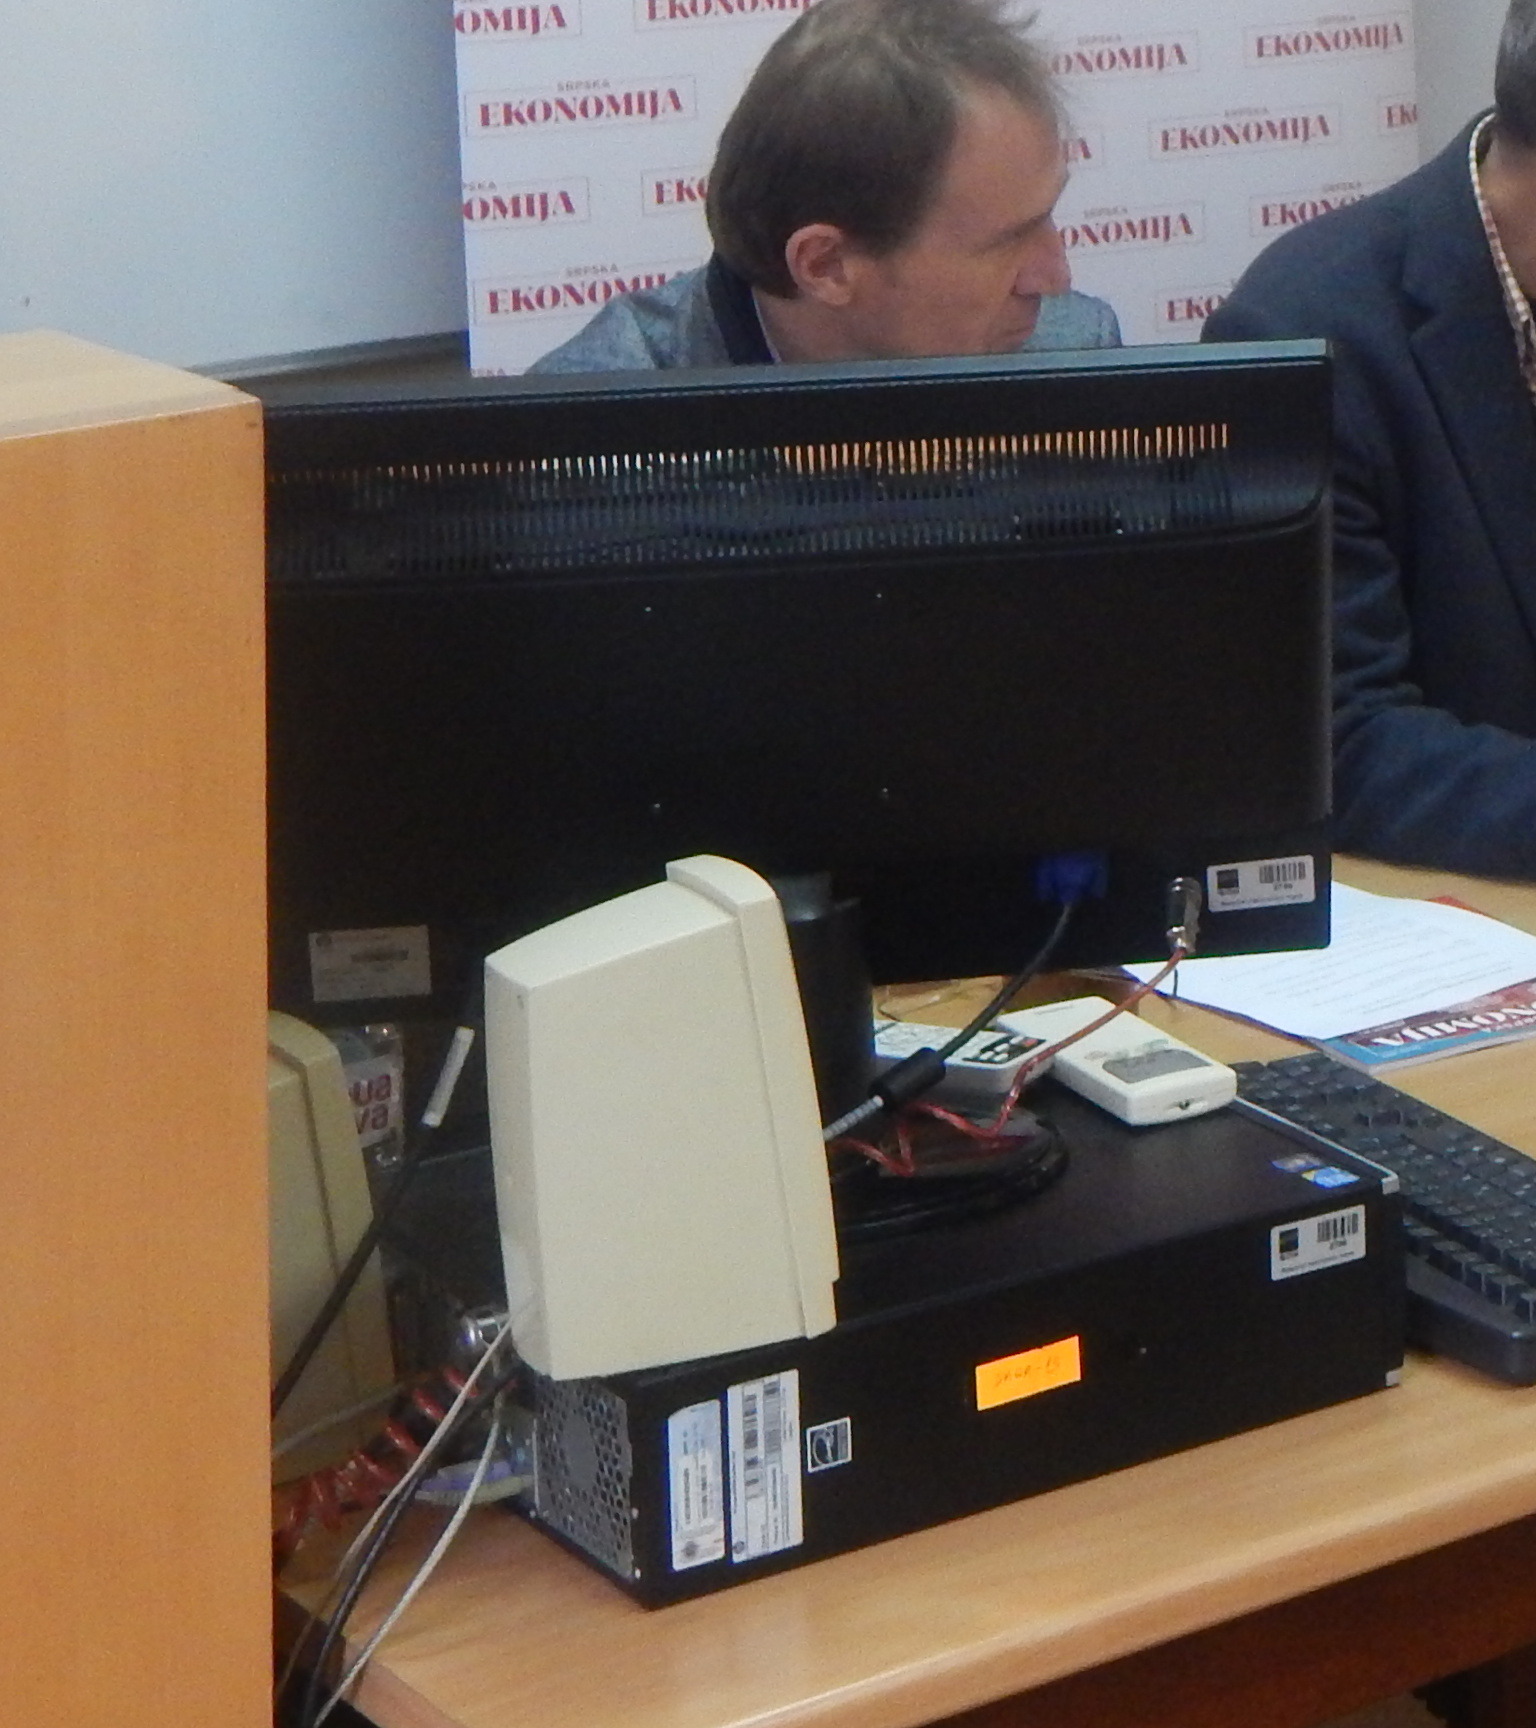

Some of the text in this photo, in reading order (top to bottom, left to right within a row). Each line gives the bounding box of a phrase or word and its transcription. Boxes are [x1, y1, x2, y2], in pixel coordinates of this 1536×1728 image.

[454, 3, 567, 35] OMIJA
[1051, 43, 1187, 73] ONOMIJA
[1256, 22, 1404, 59] EKONOMIJA
[478, 86, 683, 129] EKONOMIJA
[1160, 113, 1331, 153] EKONOMIJA
[462, 189, 575, 222] OMIJA
[1060, 212, 1194, 248] ONOMIJA
